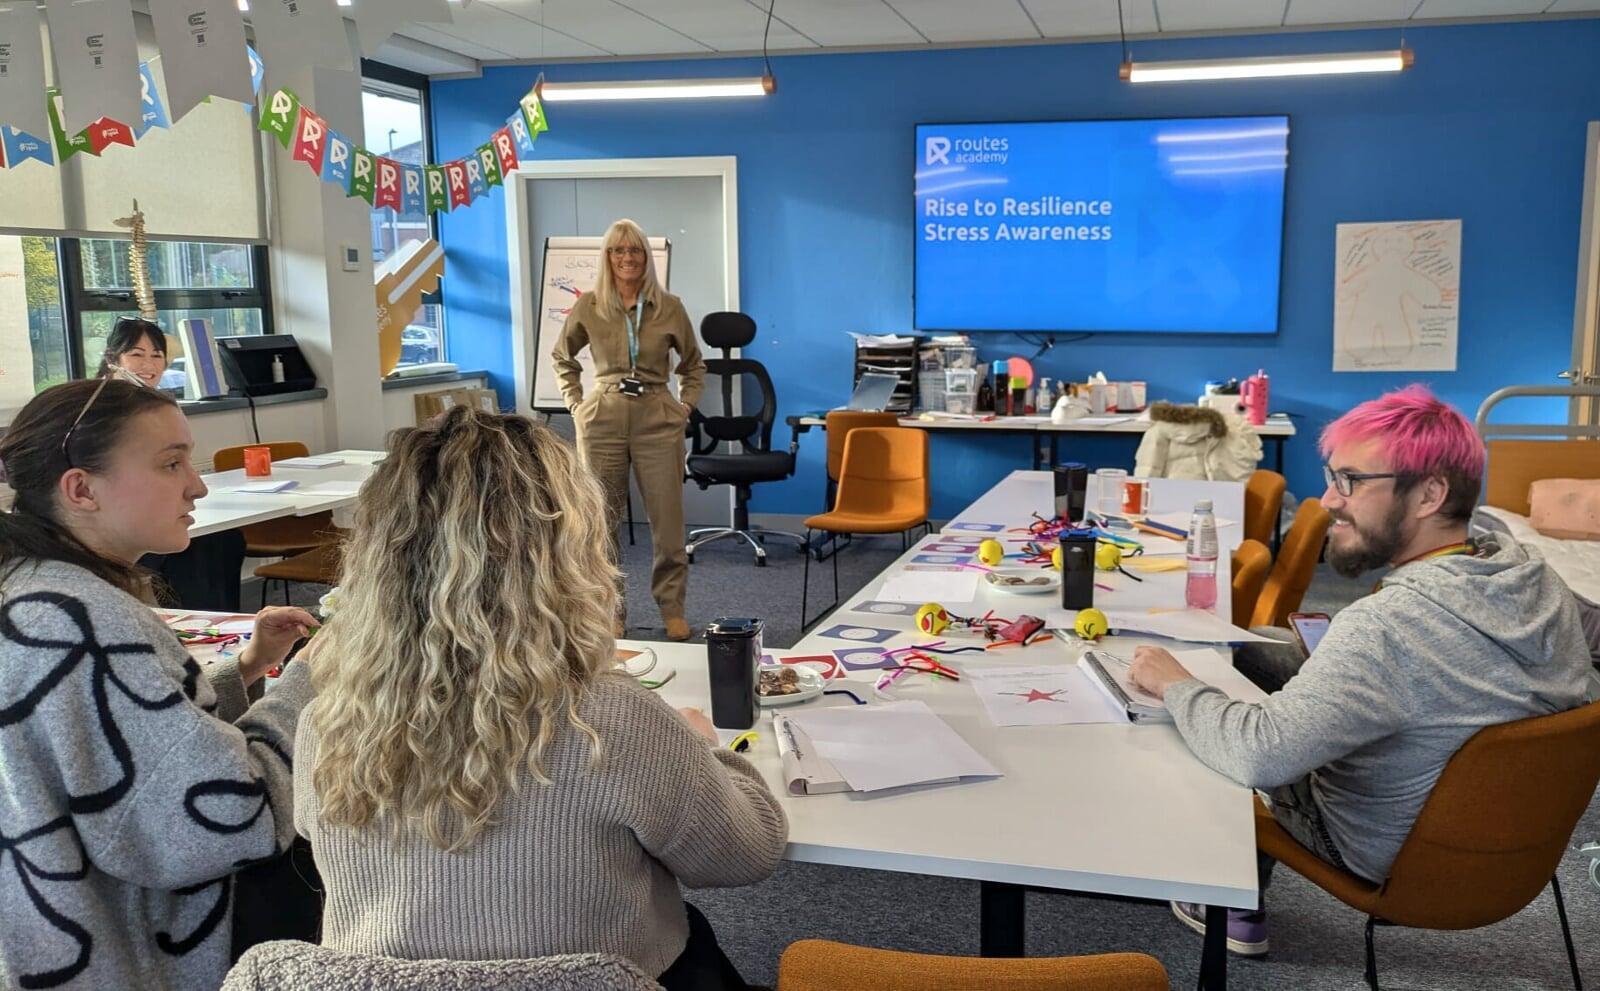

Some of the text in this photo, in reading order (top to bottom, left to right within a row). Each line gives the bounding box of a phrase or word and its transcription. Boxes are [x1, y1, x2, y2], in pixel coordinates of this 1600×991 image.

[955, 136, 1009, 151] routes
[955, 151, 1009, 165] academy
[925, 197, 1112, 216] Rise to Resilience
[925, 223, 1112, 241] Stress Awareness
